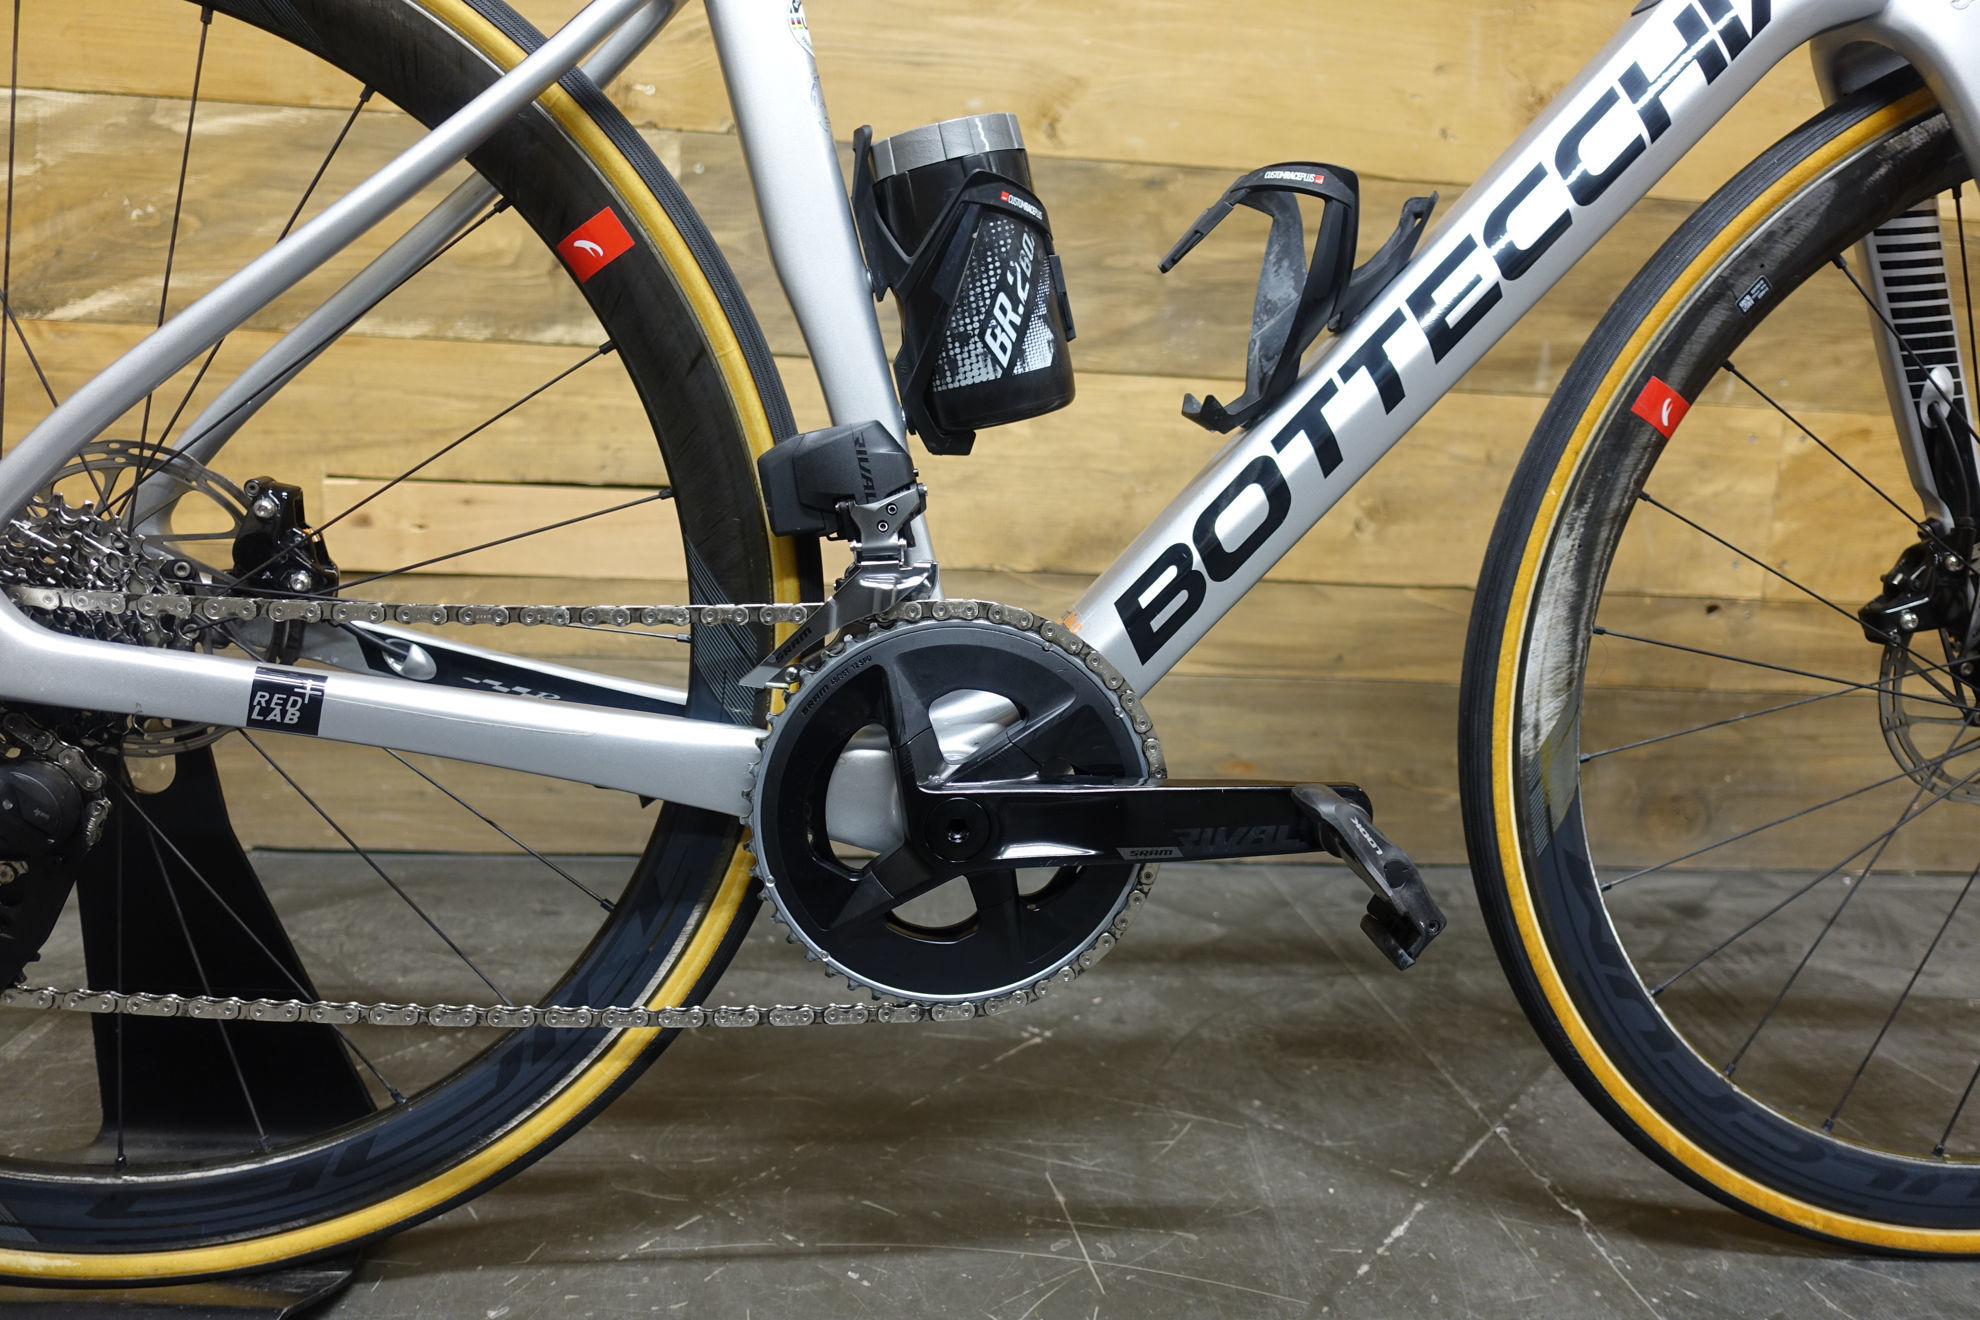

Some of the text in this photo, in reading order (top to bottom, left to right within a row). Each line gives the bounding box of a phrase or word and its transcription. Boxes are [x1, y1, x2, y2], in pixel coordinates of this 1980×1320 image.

[251, 706, 300, 724] LAB
[1350, 816, 1383, 855] LOOK
[1129, 849, 1173, 858] SRAM
[1563, 847, 1980, 1199] ULCRUM
